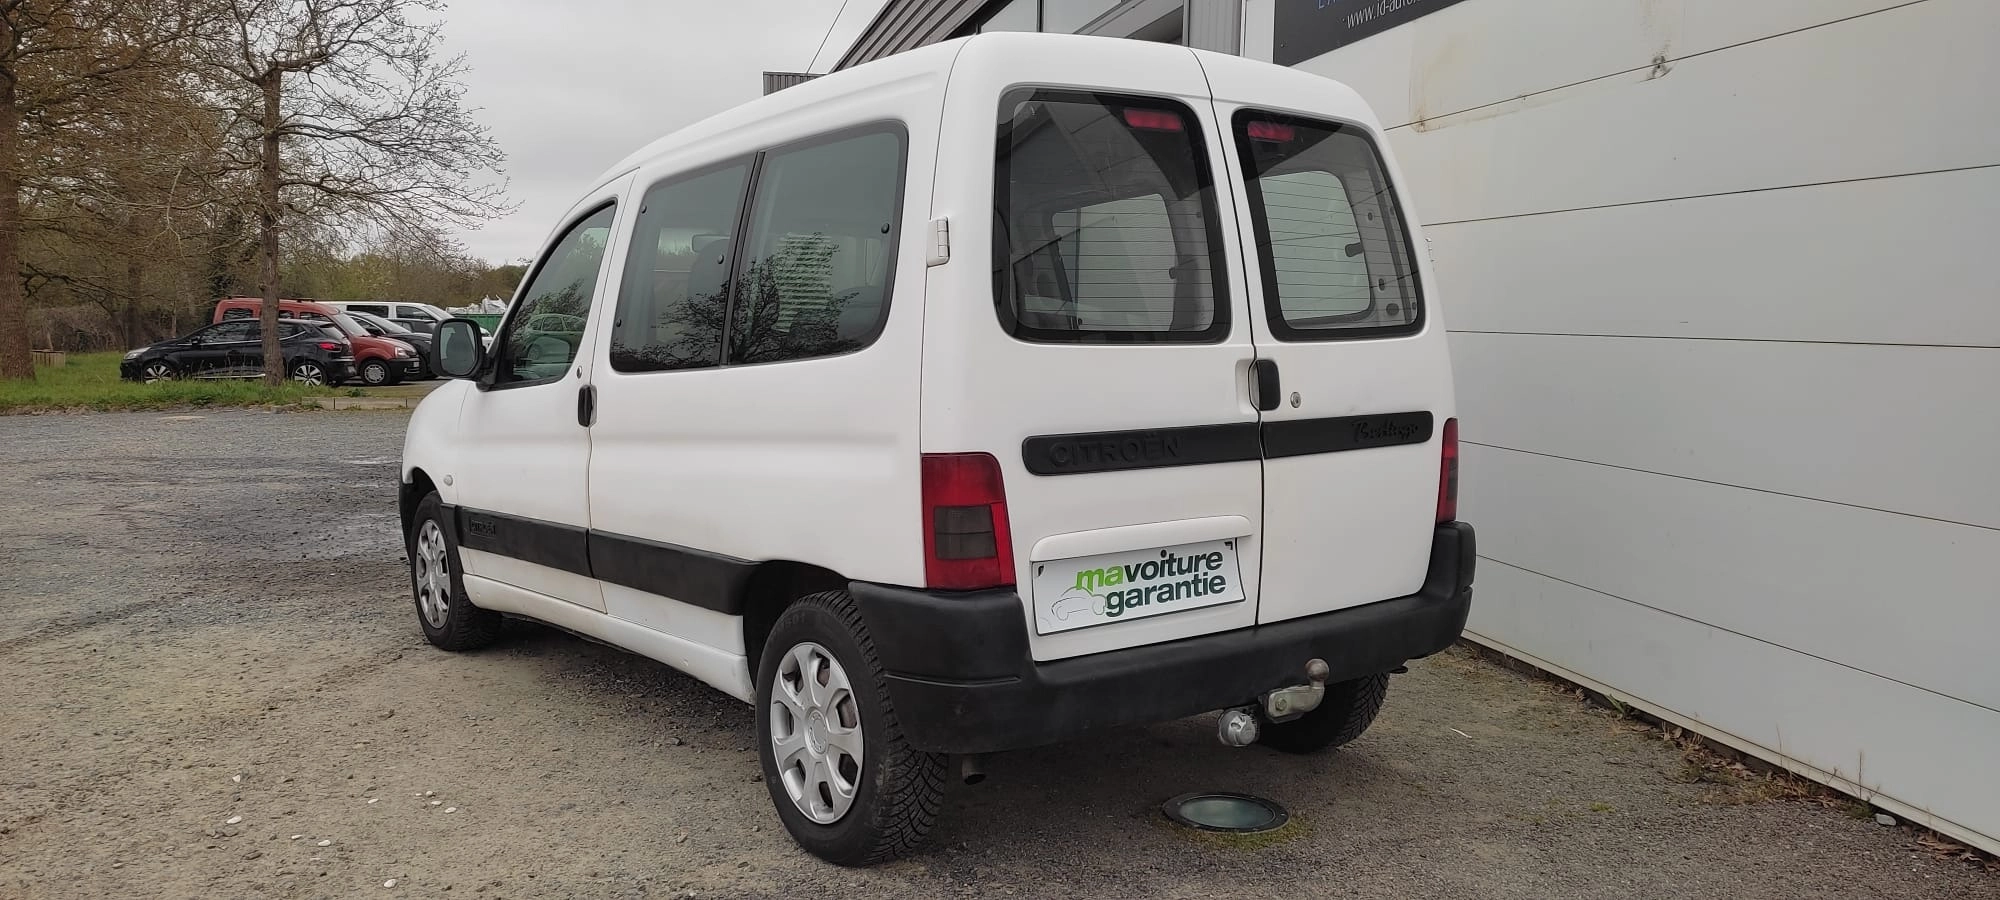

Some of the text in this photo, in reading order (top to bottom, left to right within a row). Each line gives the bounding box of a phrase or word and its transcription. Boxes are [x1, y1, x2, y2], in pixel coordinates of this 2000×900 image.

[1346, 0, 1419, 29] www.id-au
[1048, 432, 1183, 467] CITROËN
[1105, 572, 1226, 617] garantie
